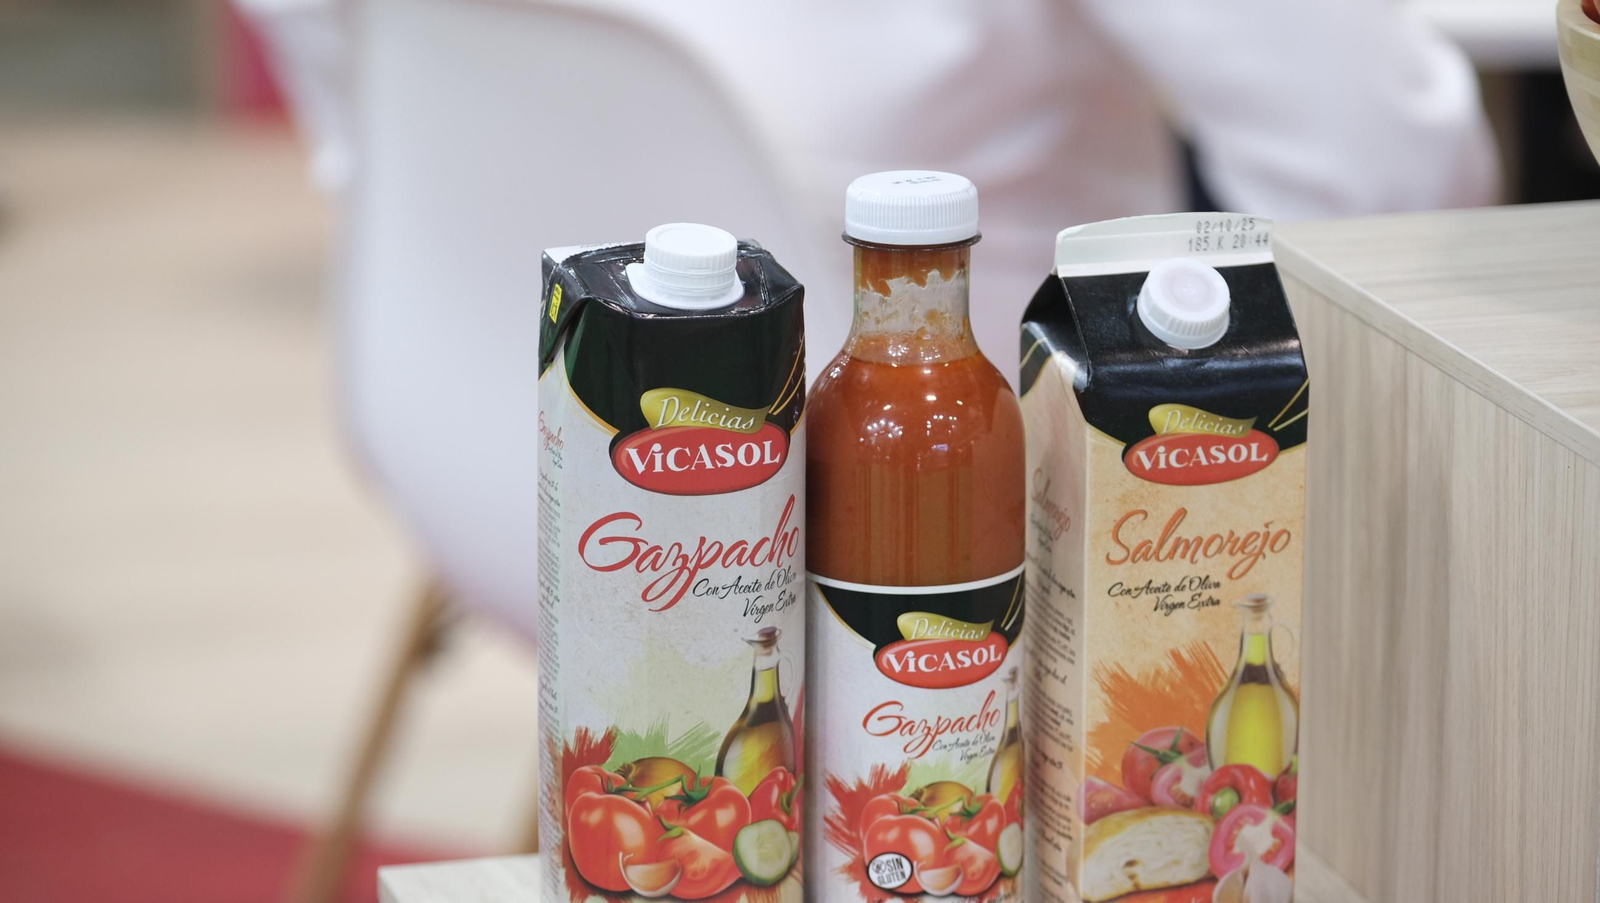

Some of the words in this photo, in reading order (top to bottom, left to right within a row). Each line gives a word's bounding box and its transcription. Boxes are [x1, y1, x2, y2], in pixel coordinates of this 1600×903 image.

[1196, 217, 1255, 234] 02/10/25
[1232, 232, 1269, 249] 20:44
[655, 396, 755, 430] Delicias
[1163, 410, 1243, 434] Delicias
[578, 493, 800, 613] Gazpacho
[1105, 507, 1291, 581] Salmorejo
[692, 578, 719, 597] Con
[718, 575, 762, 599] Aceite
[764, 568, 777, 591] de
[1107, 581, 1132, 597] Con
[1131, 579, 1171, 599] Aceite
[1174, 575, 1190, 592] de
[743, 595, 775, 623] Virgen
[775, 588, 797, 613] Extra
[1153, 594, 1185, 617] Virgen
[1187, 592, 1221, 611] Extra
[911, 617, 984, 640] Delicias
[862, 689, 1001, 760] Gazpacho
[886, 857, 904, 872] SIN
[876, 871, 907, 886] GLUTEN
